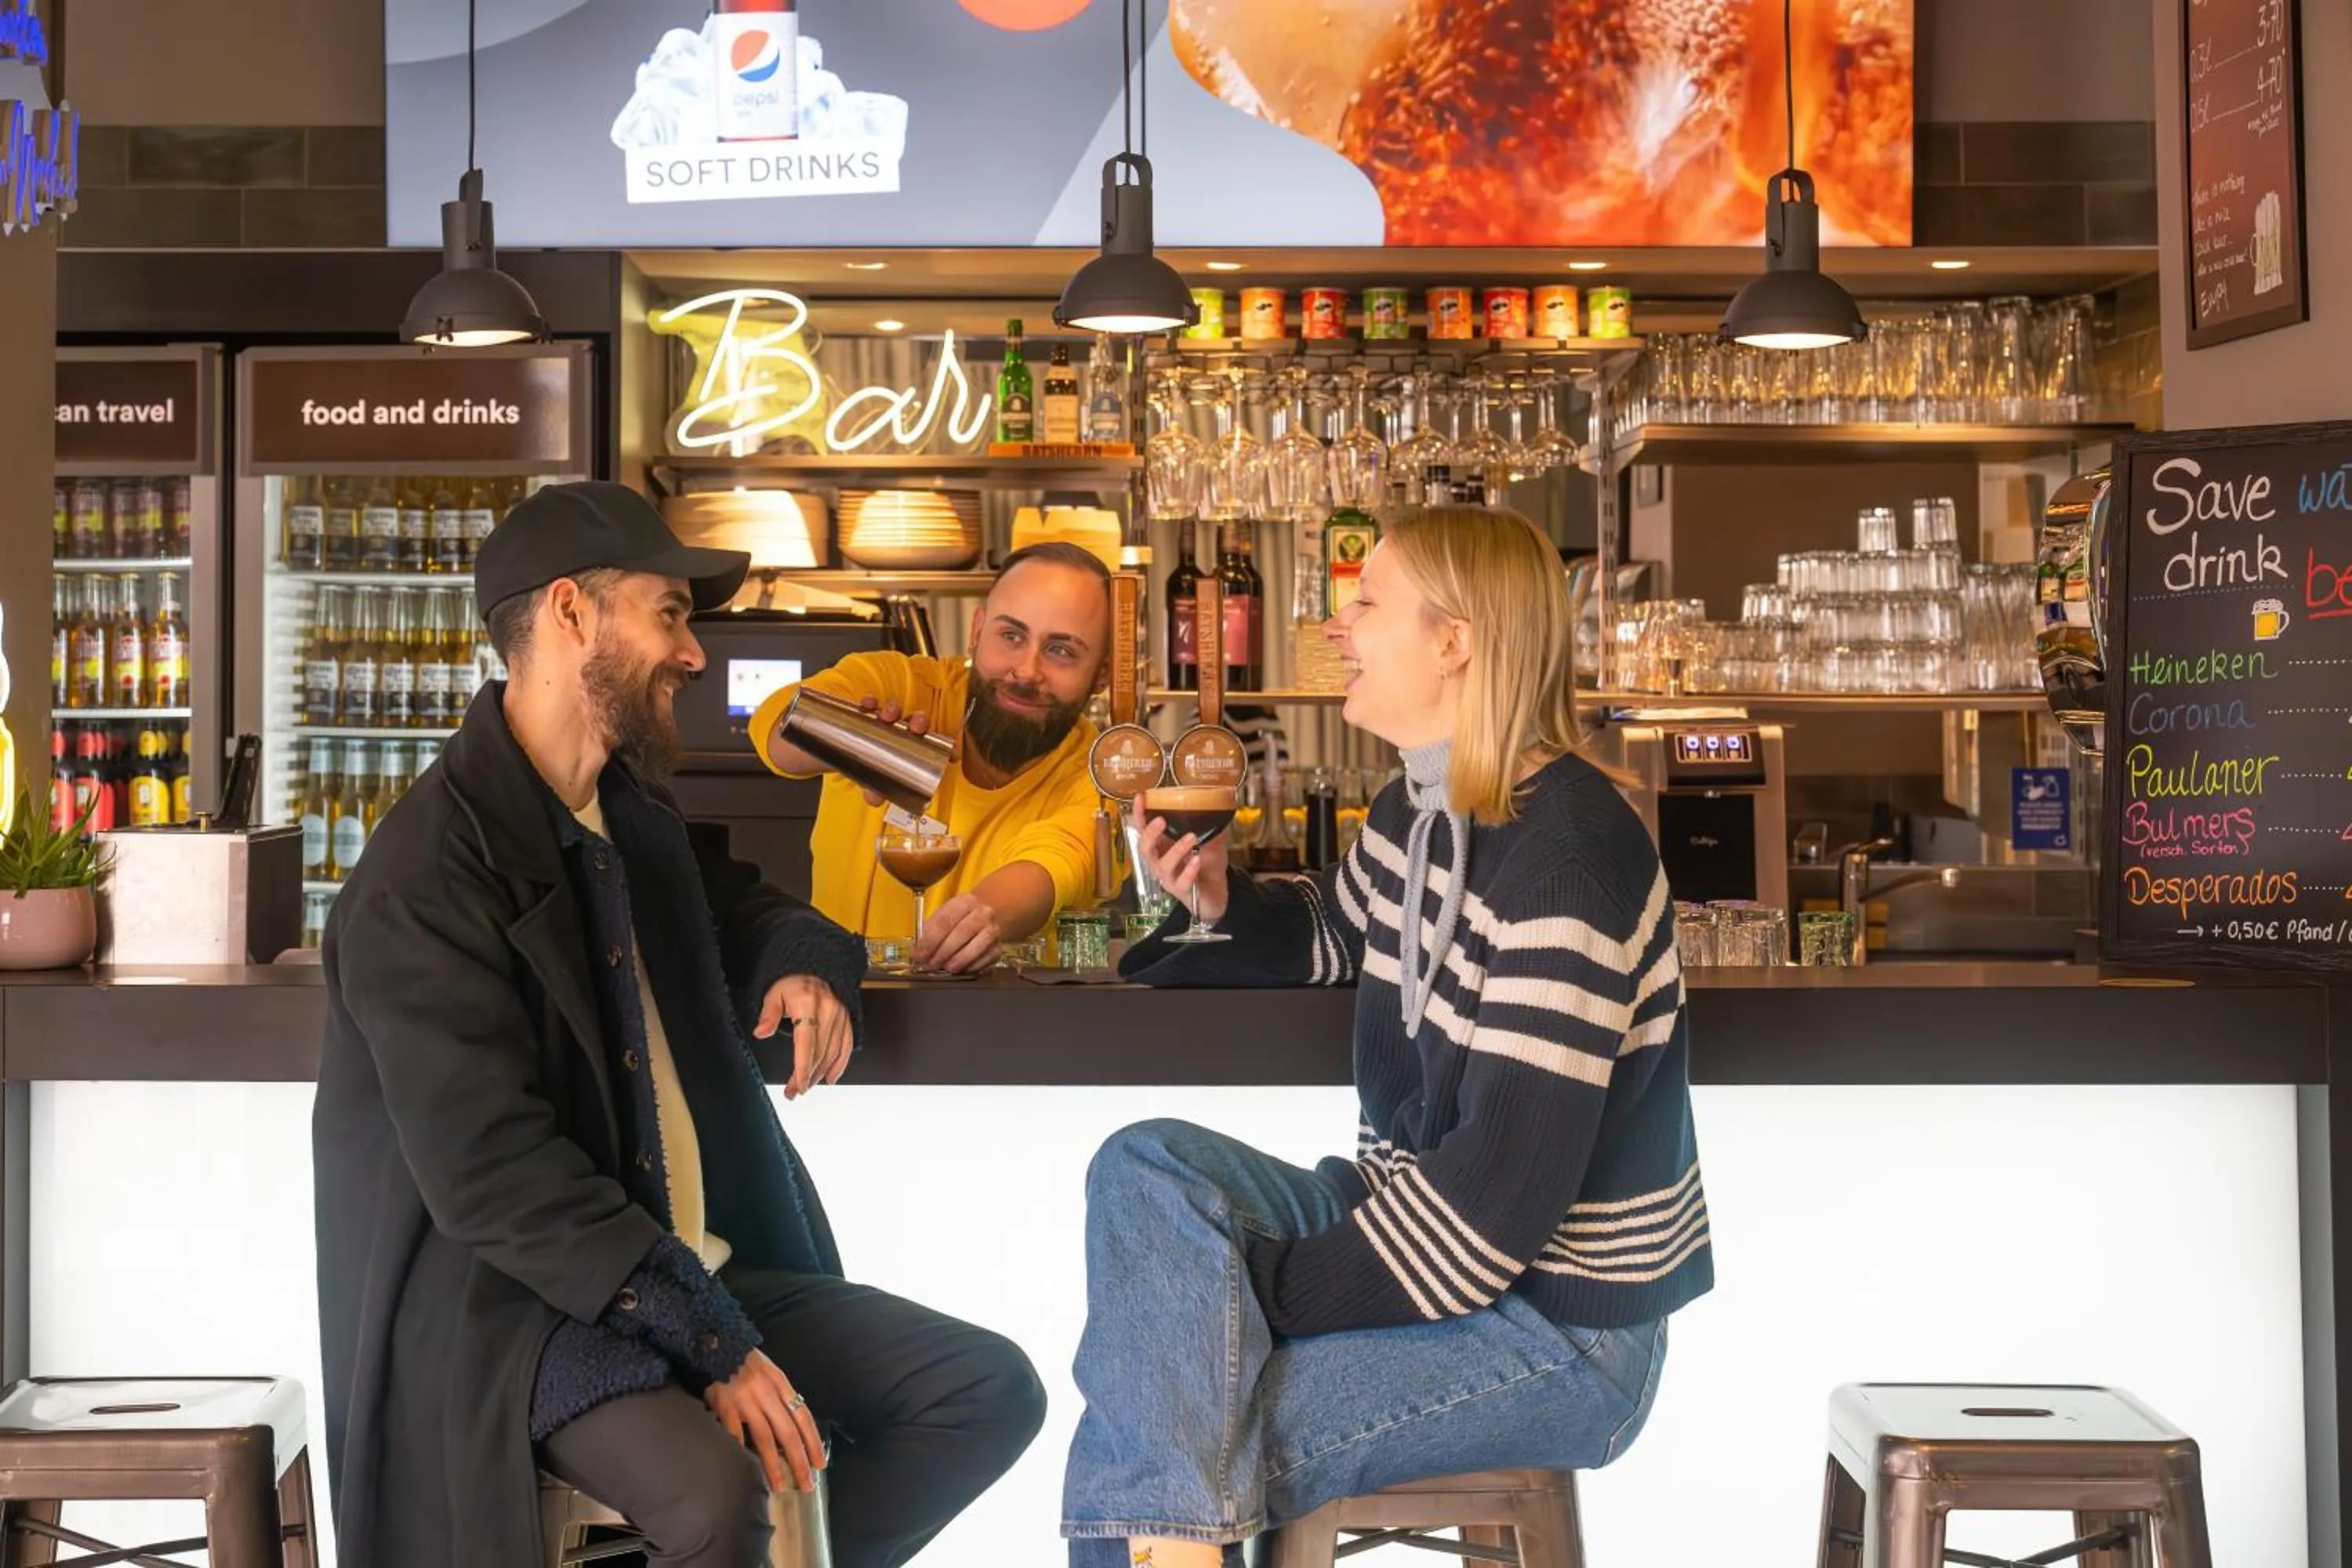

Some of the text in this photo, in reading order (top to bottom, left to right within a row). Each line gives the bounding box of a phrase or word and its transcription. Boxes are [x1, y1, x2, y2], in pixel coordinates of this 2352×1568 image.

[646, 151, 880, 187] SOFT DRINKS
[659, 289, 992, 451] Bar
[96, 397, 175, 423] travel
[301, 398, 521, 426] food and drinks
[2146, 457, 2277, 535] Save
[2164, 531, 2288, 592] drink
[2129, 649, 2279, 685] Heineken
[2129, 692, 2256, 735] Corona
[2126, 744, 2280, 798] Paulaner
[2122, 800, 2256, 845] Bulmers
[2124, 866, 2298, 921] Desperados
[2227, 920, 2279, 940] 0,50€
